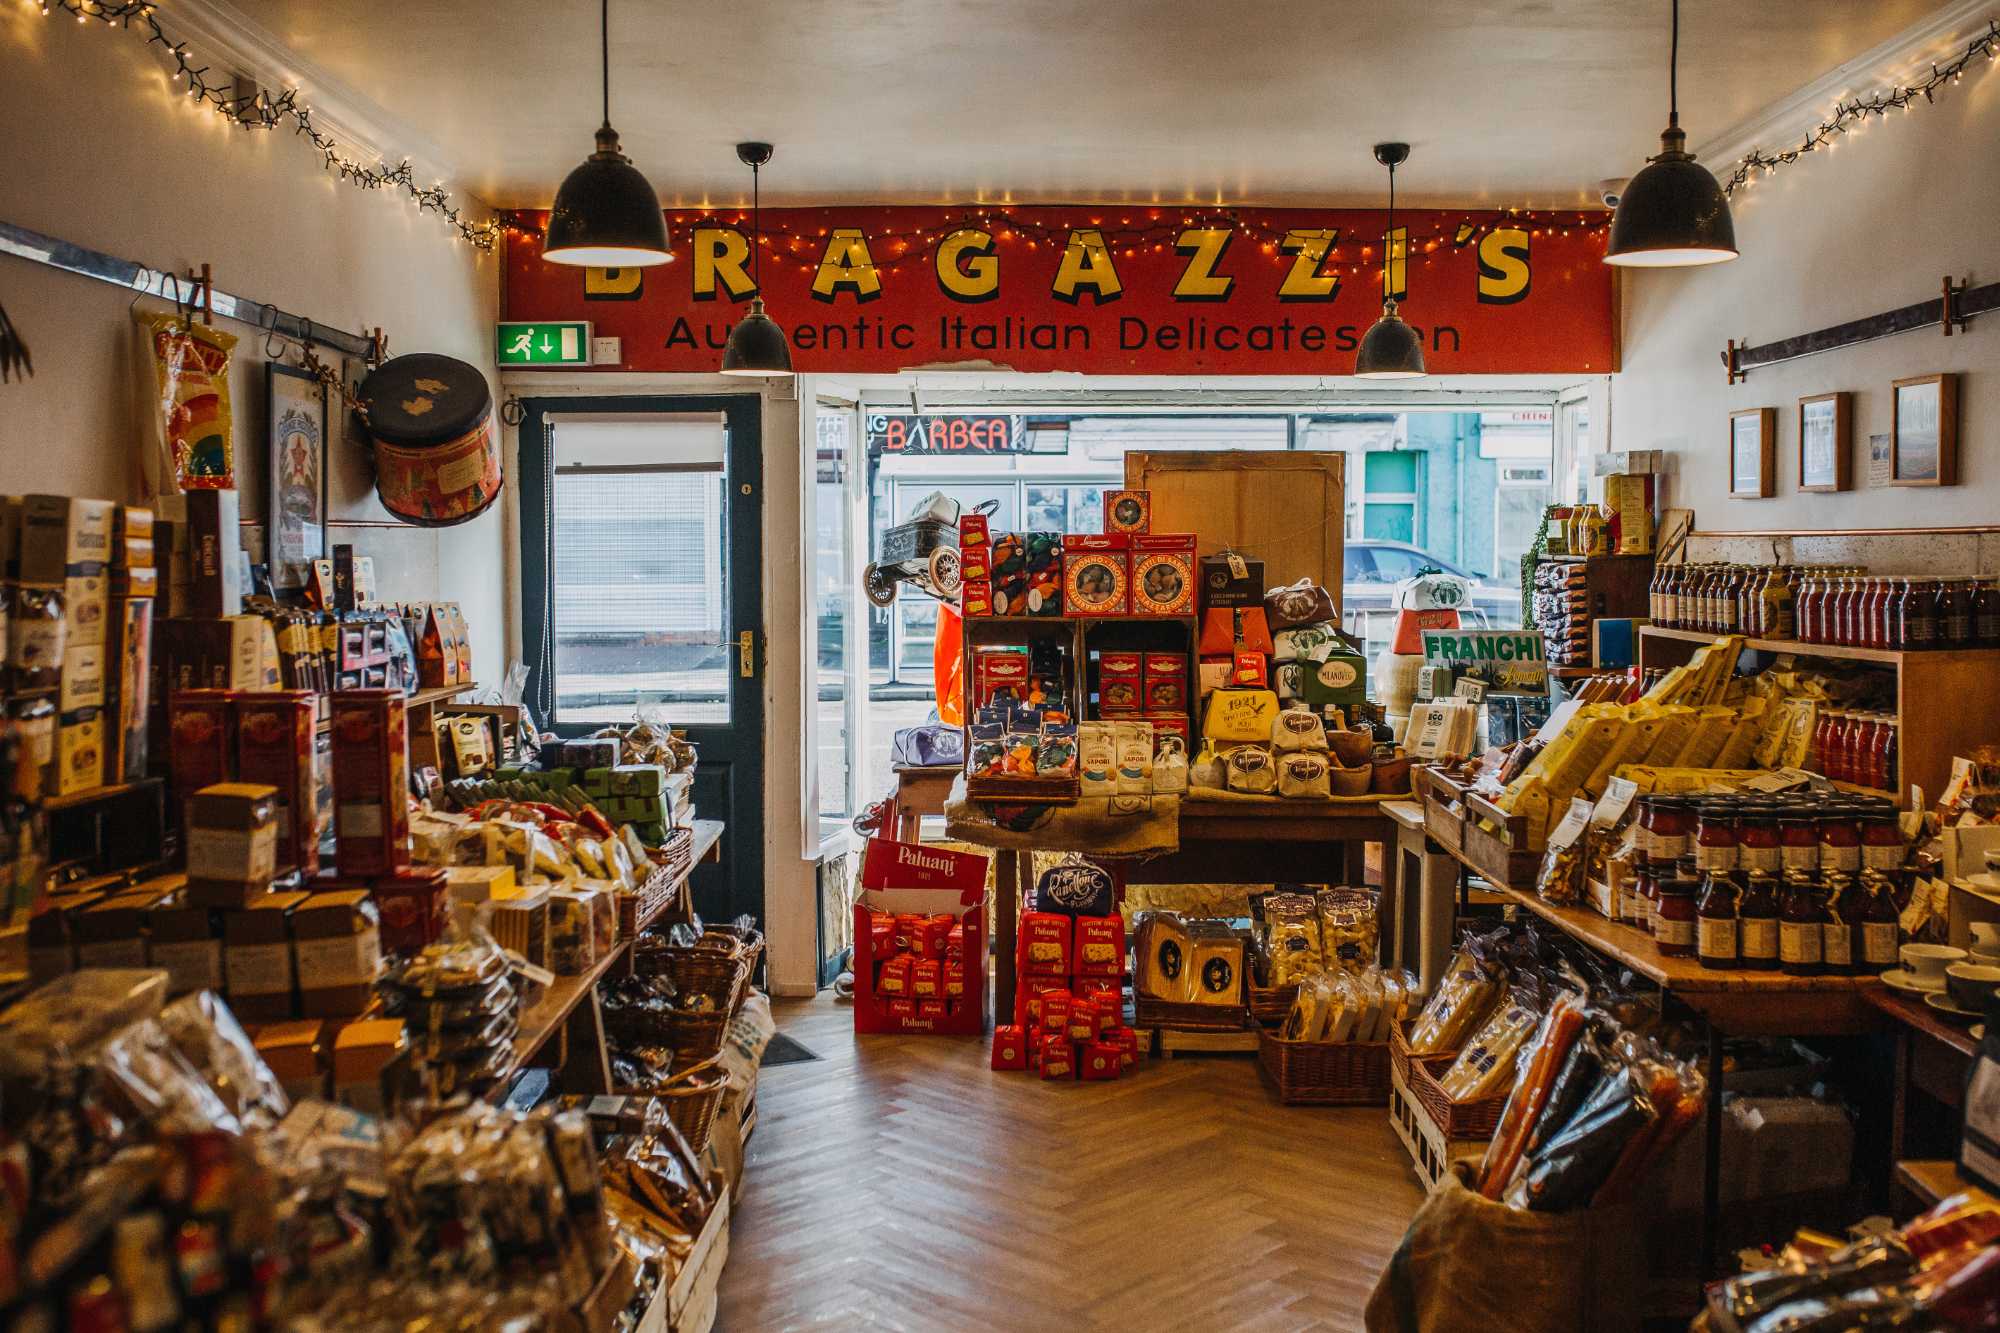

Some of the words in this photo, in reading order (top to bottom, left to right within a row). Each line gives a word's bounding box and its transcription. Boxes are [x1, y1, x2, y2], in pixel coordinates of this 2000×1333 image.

[664, 316, 915, 351] Auentic
[941, 316, 1091, 352] Italian
[1118, 316, 1461, 352] Delicatesn
[1512, 412, 1552, 421] CHIN
[887, 419, 1008, 449] BARBER
[1424, 636, 1543, 662] FRANCHI
[897, 846, 956, 877] Paluani
